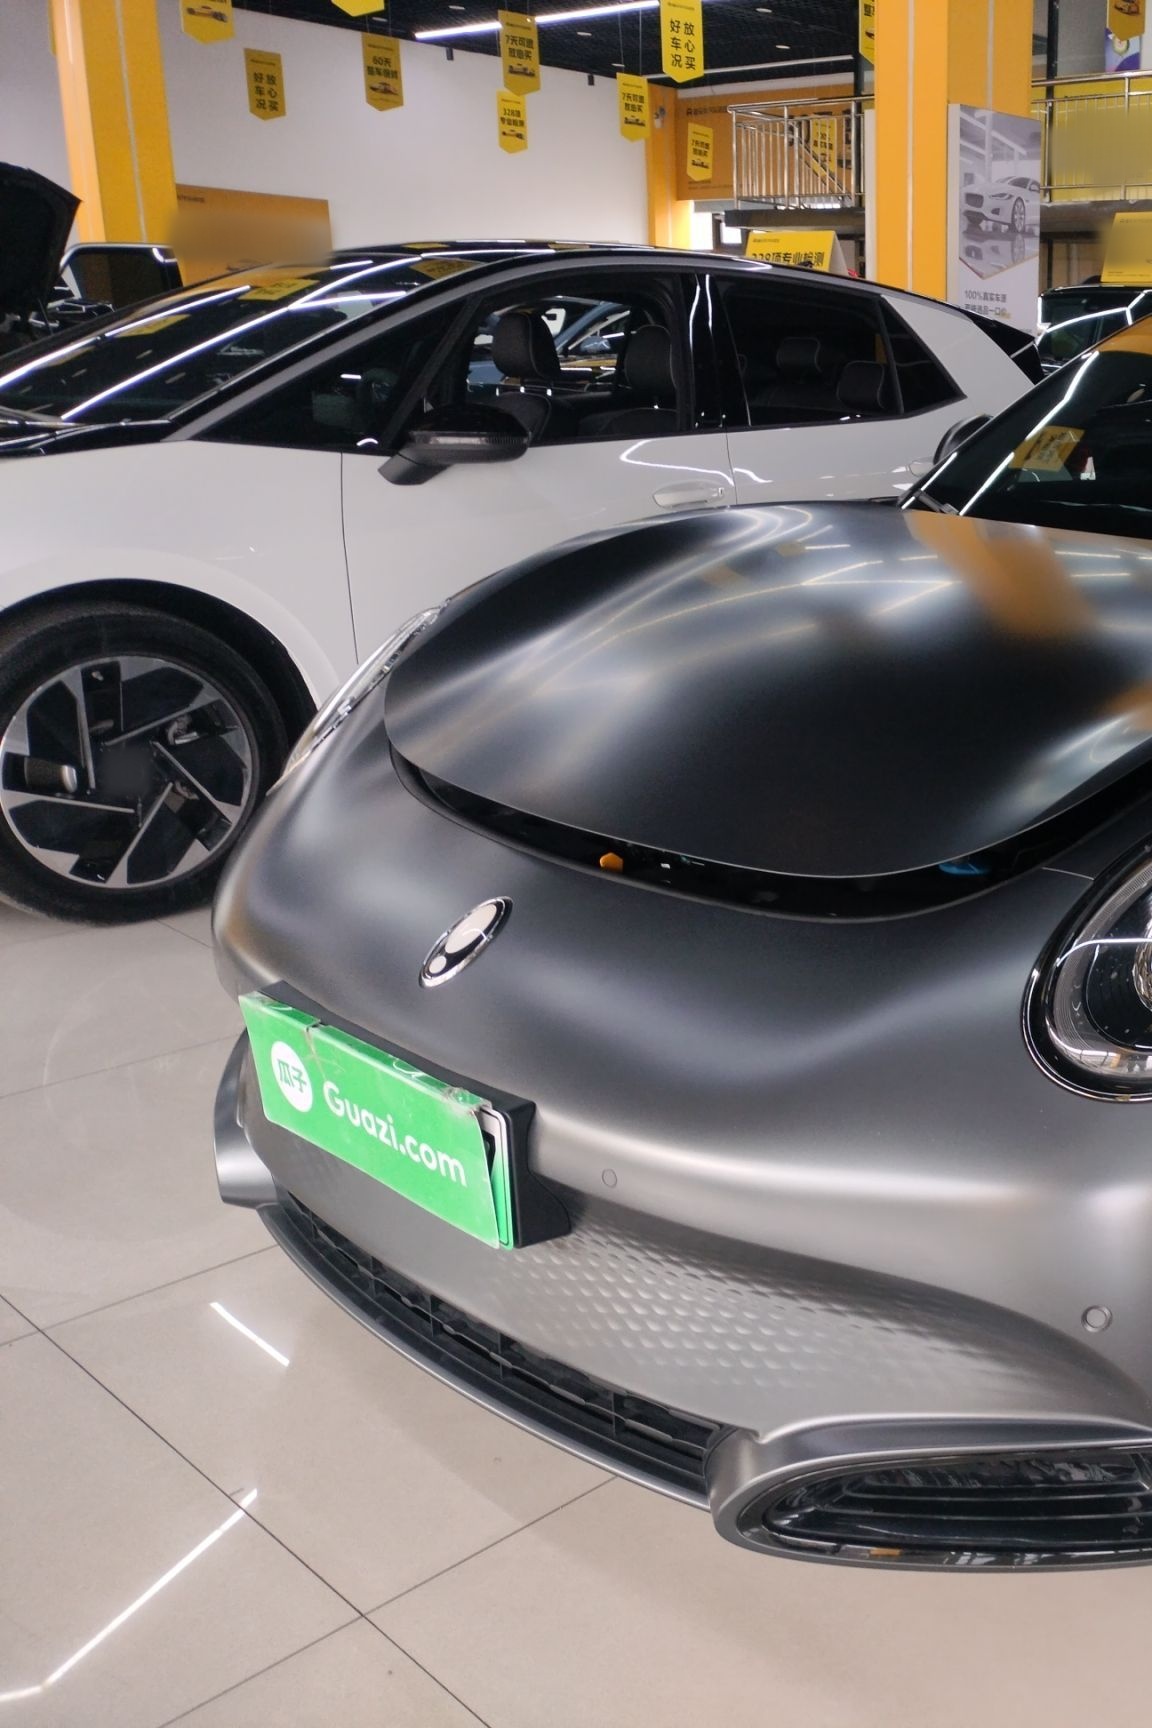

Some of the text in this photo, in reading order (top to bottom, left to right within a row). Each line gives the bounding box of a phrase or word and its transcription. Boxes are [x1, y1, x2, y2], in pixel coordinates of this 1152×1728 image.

[670, 18, 682, 68] 好车况
[684, 22, 696, 70] 放心买
[277, 1058, 307, 1093] 瓜子
[323, 1081, 468, 1188] Guazi.com
